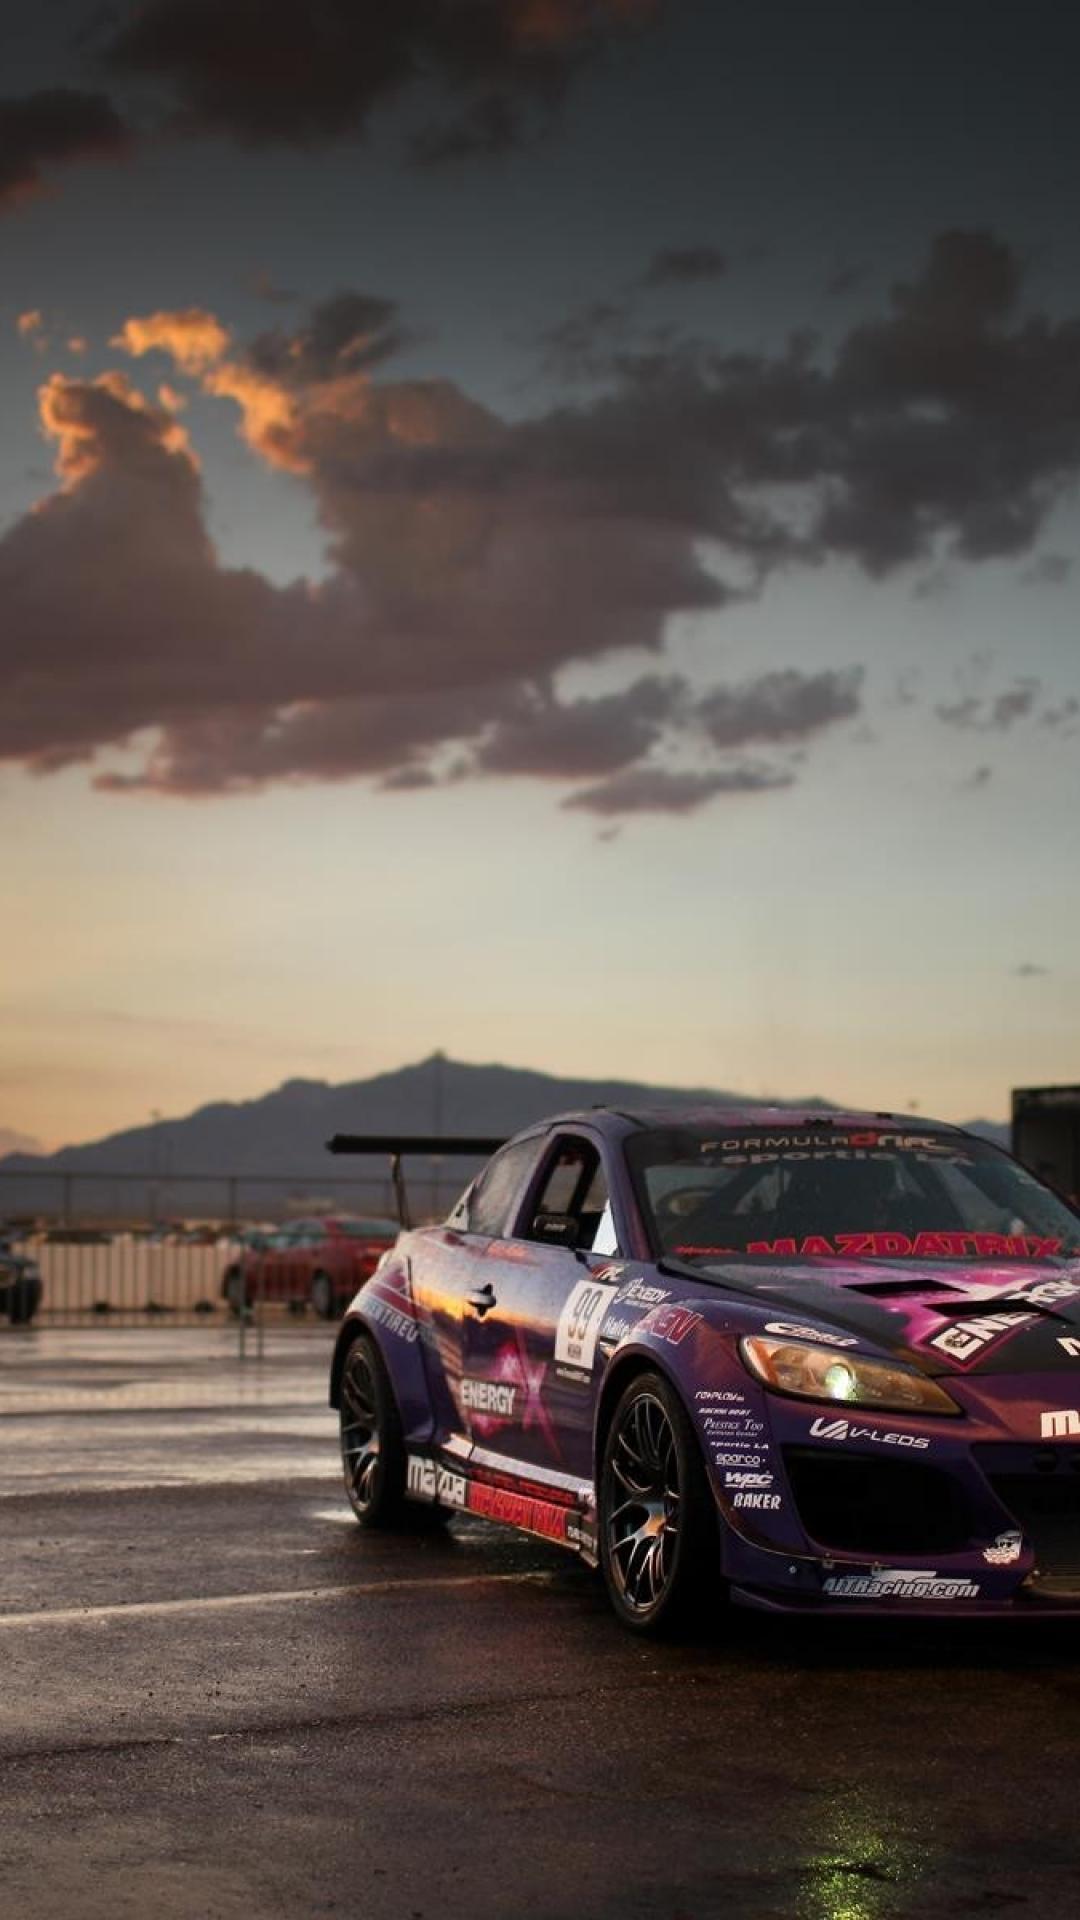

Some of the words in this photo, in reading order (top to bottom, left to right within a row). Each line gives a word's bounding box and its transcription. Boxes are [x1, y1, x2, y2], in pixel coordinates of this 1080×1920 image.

[746, 1231, 1063, 1256] MAZDATRIX
[460, 1378, 516, 1416] ENERGY
[849, 1428, 931, 1450] V-LEDS
[733, 1492, 782, 1510] BAKER
